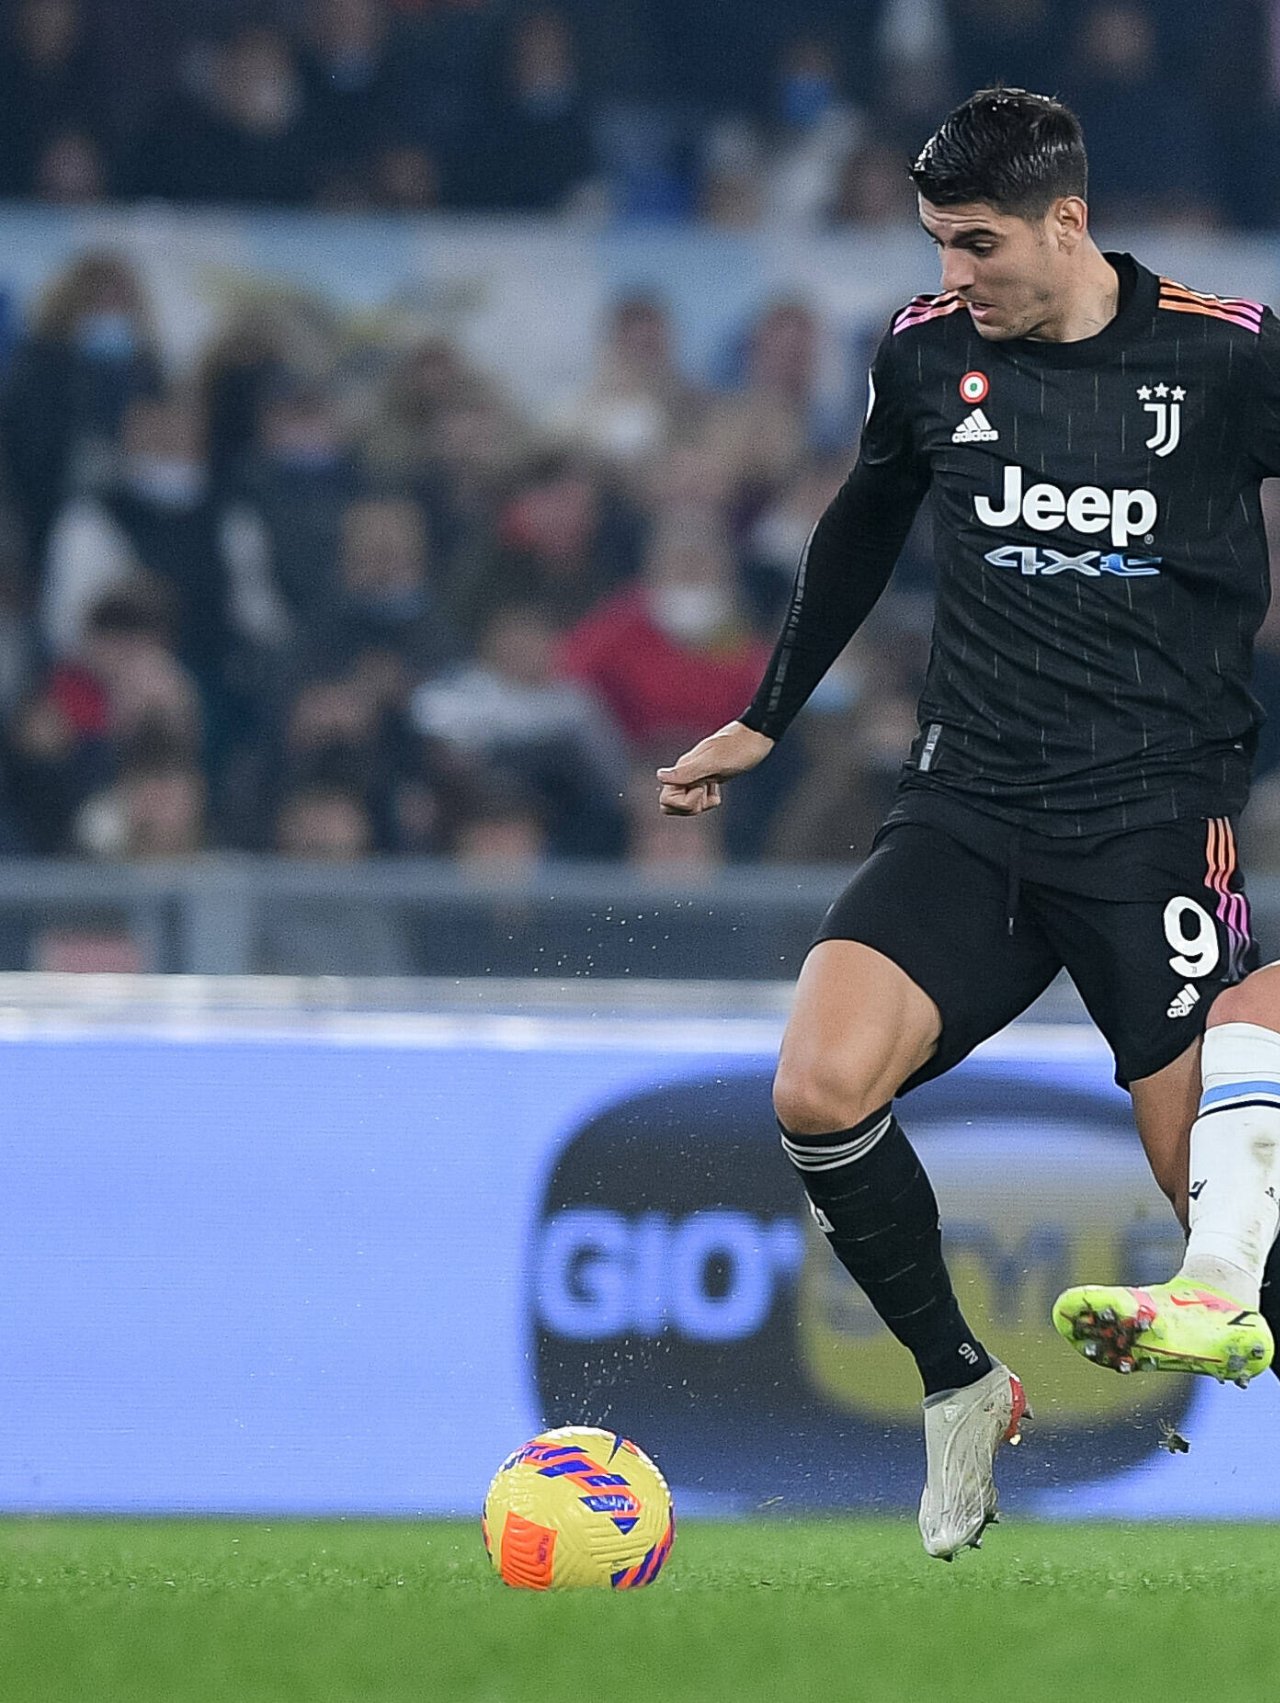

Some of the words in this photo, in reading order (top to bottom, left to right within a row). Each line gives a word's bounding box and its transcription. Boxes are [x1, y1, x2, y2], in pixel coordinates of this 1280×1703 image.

[952, 430, 999, 443] adidas
[974, 466, 1157, 547] Jeep
[1163, 896, 1219, 978] 9
